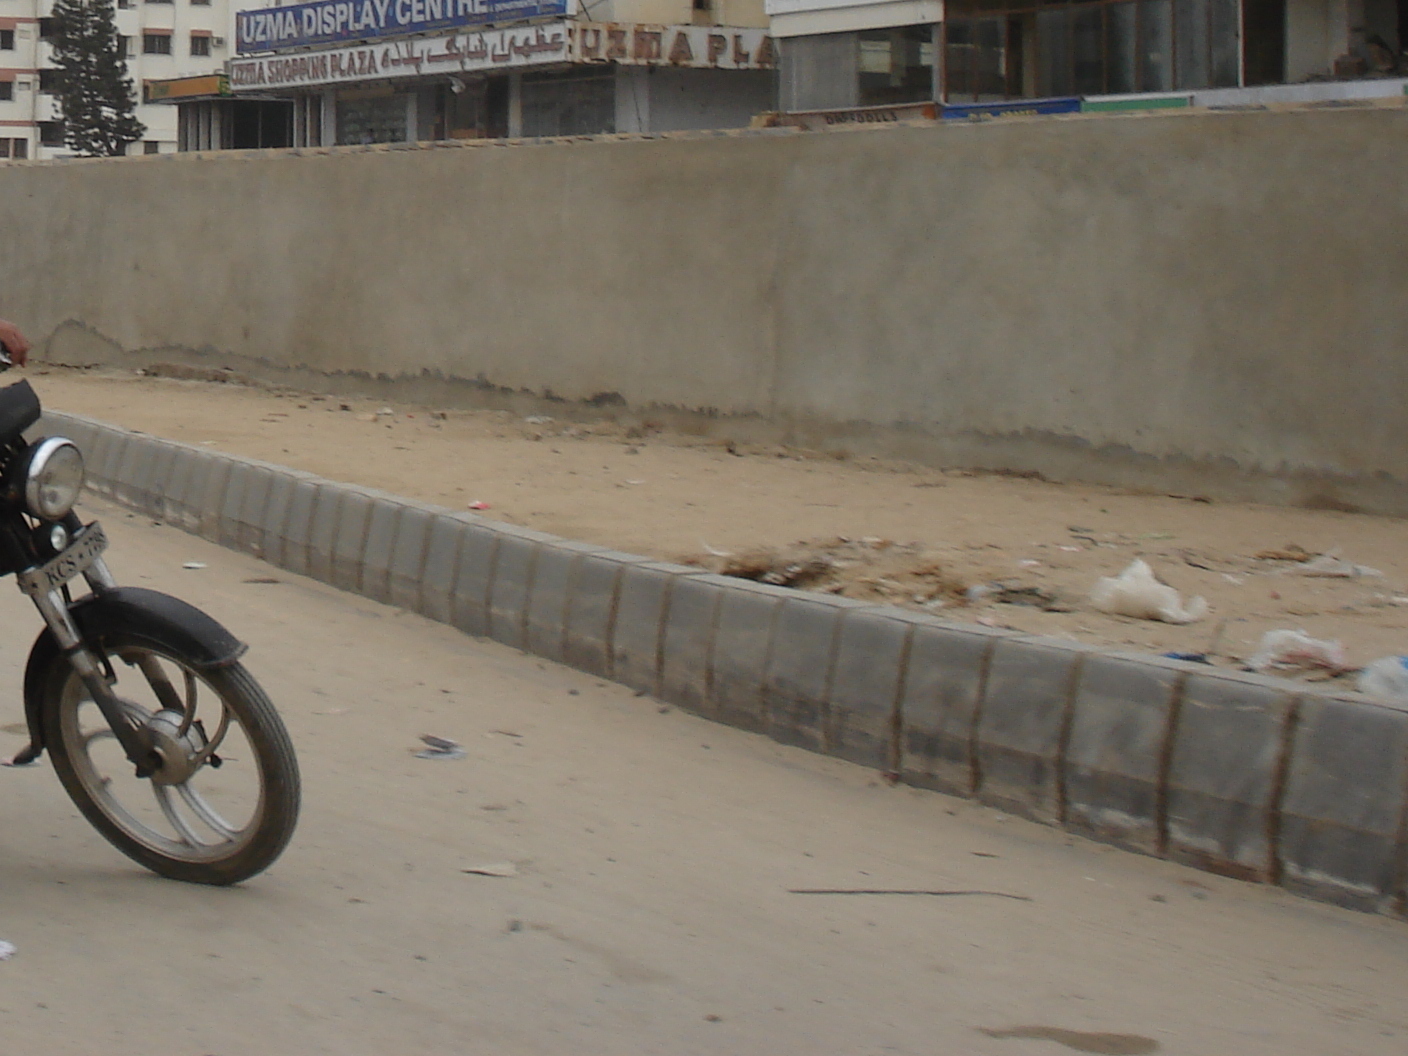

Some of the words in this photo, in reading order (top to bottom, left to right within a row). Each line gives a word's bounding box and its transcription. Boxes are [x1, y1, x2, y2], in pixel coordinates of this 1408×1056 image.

[242, 10, 298, 44] UZMA
[579, 27, 694, 64] UZMA
[230, 60, 267, 86] UZMA
[266, 53, 329, 85] SHOPPING
[328, 48, 379, 81] PLAZA
